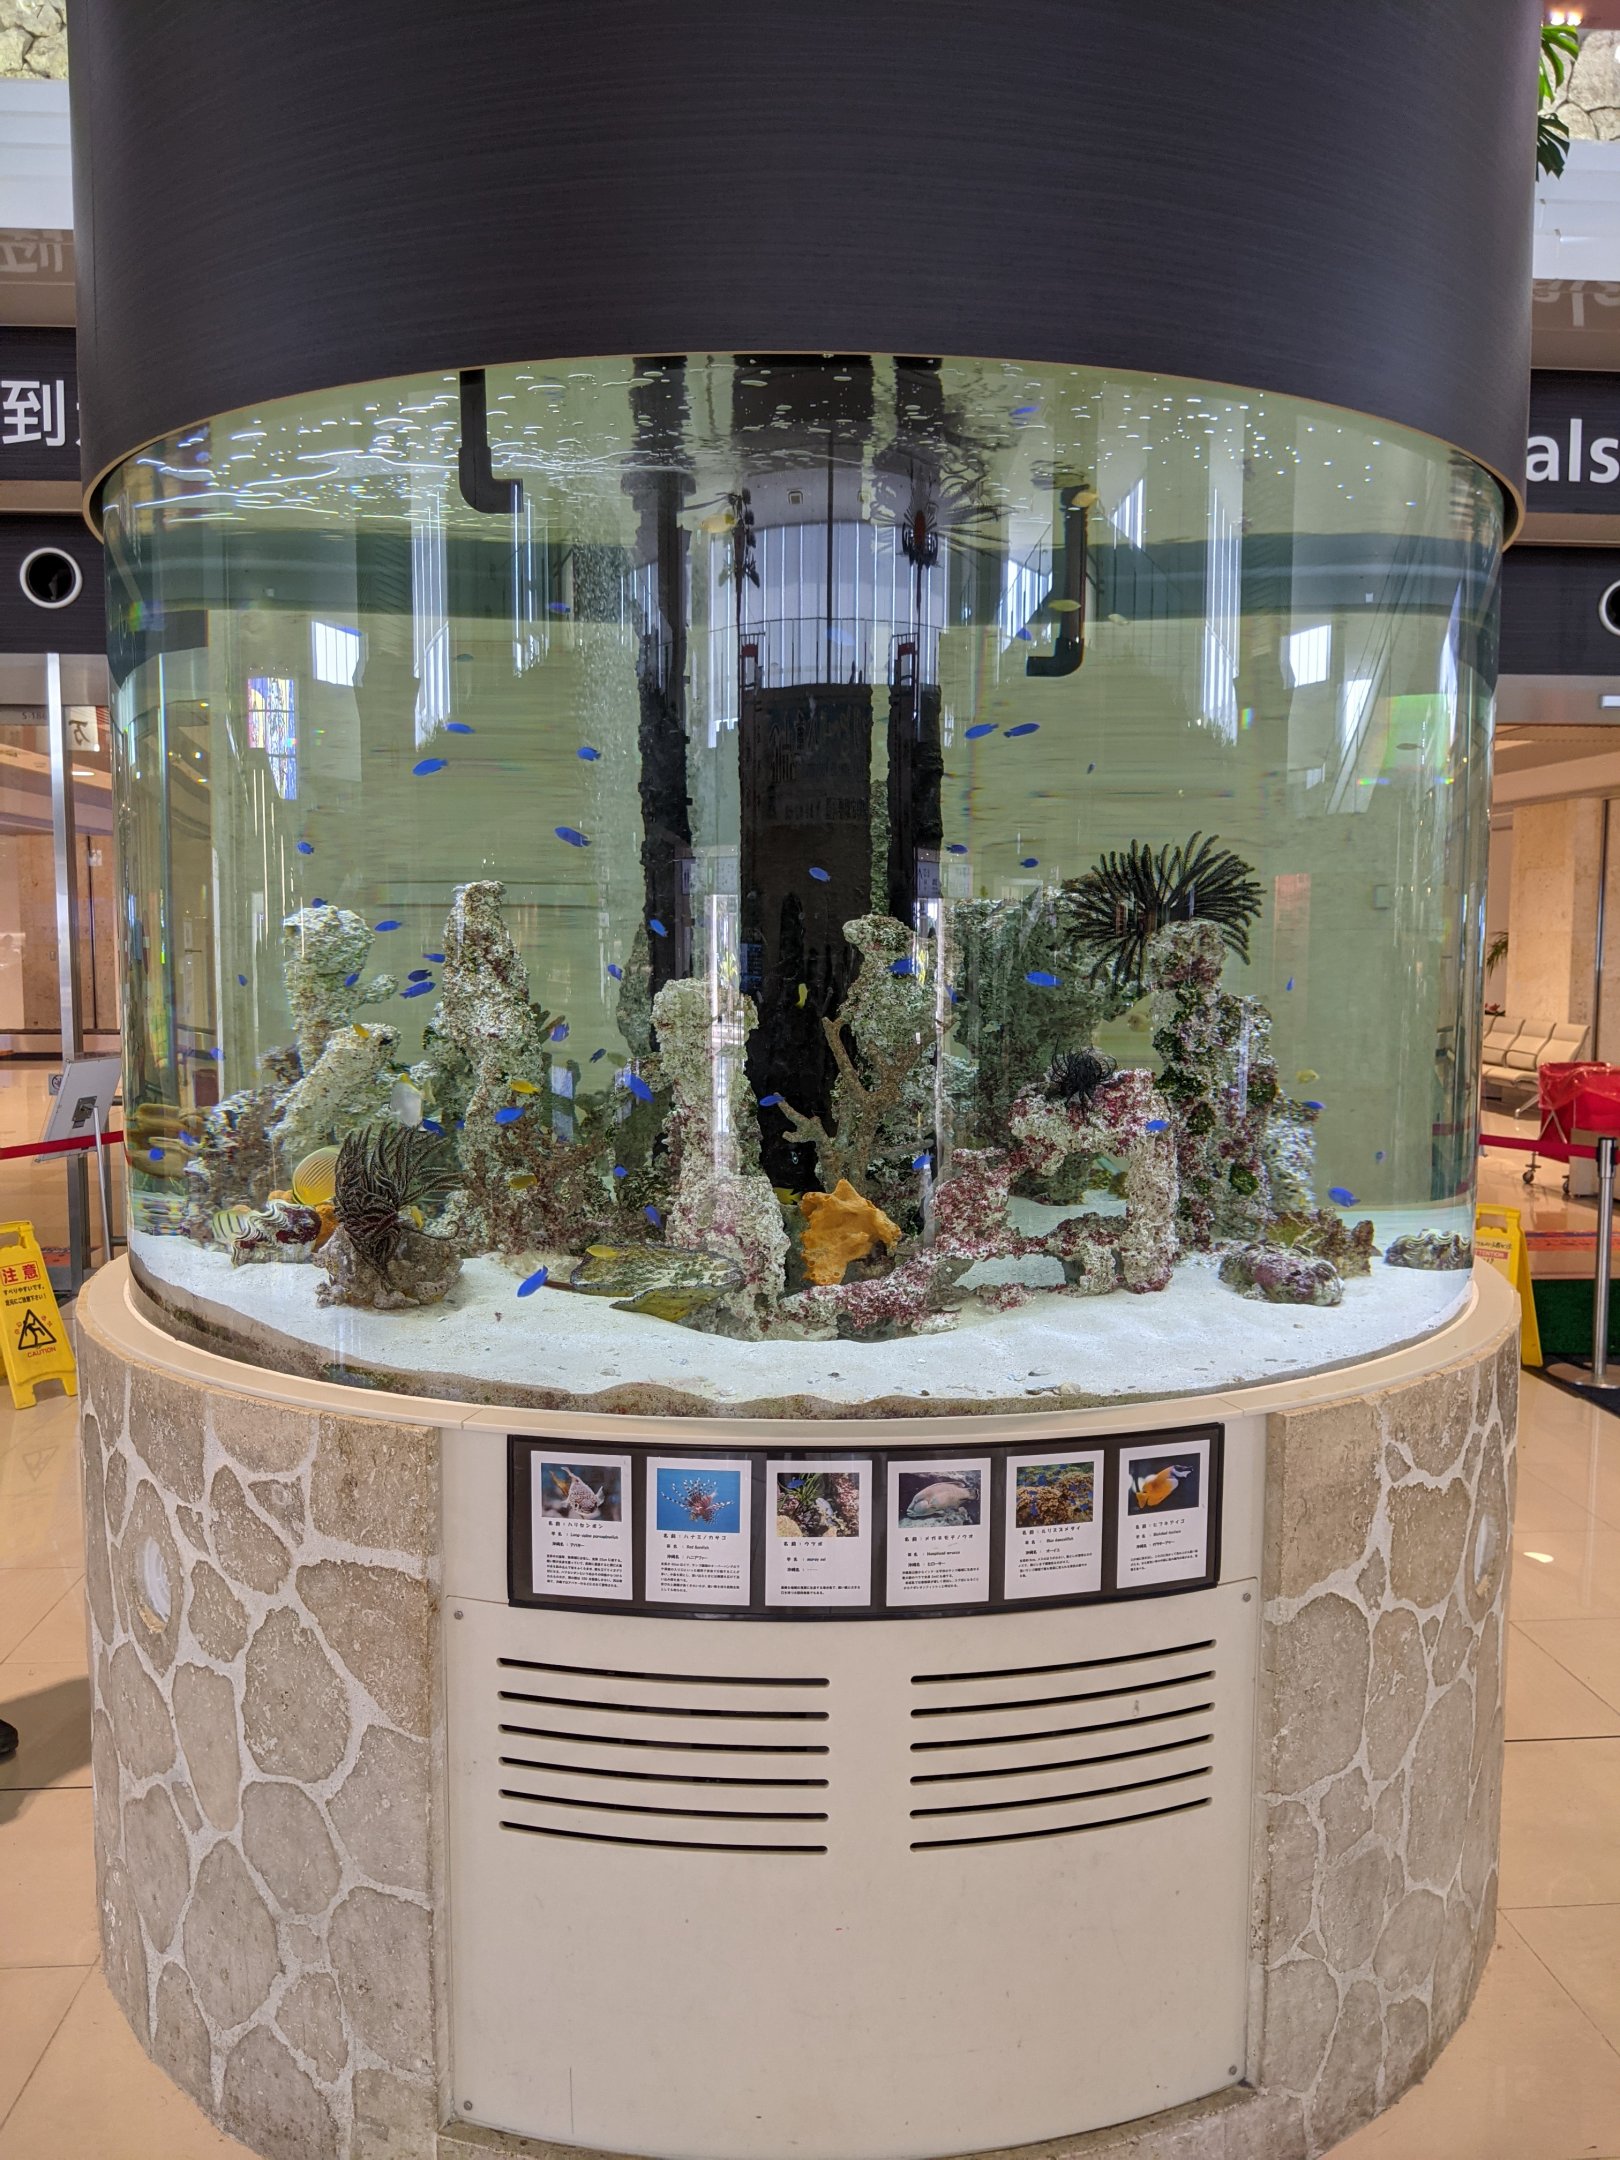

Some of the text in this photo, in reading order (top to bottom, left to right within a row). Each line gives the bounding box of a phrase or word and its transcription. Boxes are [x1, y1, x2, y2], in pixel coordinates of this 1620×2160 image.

[1, 380, 80, 446] 到
[2, 1264, 39, 1284] 注意
[27, 1346, 57, 1358] CAUTION
